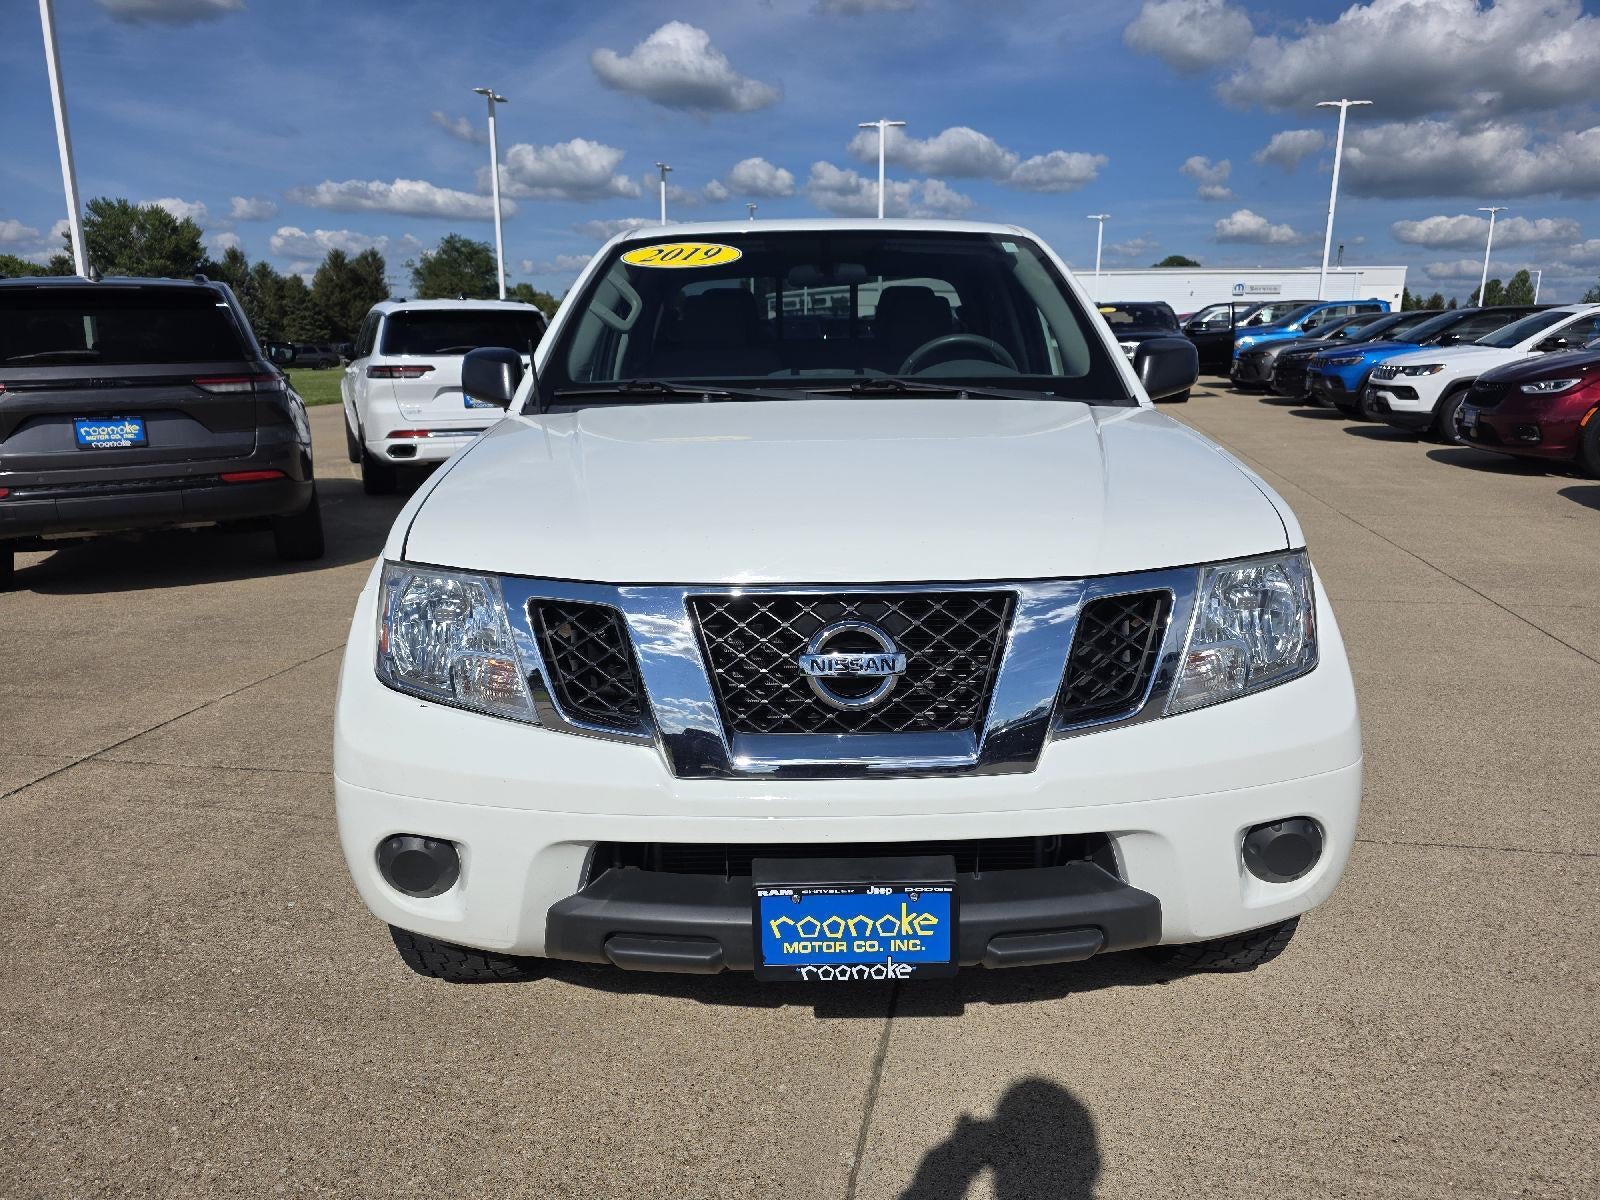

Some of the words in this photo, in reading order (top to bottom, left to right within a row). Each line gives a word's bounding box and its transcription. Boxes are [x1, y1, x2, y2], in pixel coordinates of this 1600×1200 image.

[639, 247, 723, 262] 2019
[810, 658, 896, 672] NISSAN
[757, 889, 794, 897] RAM
[866, 886, 893, 895] Jeep
[769, 902, 939, 938] roanoke
[783, 941, 848, 954] MOTOR
[853, 940, 884, 952] CO.
[890, 939, 926, 951] INC.
